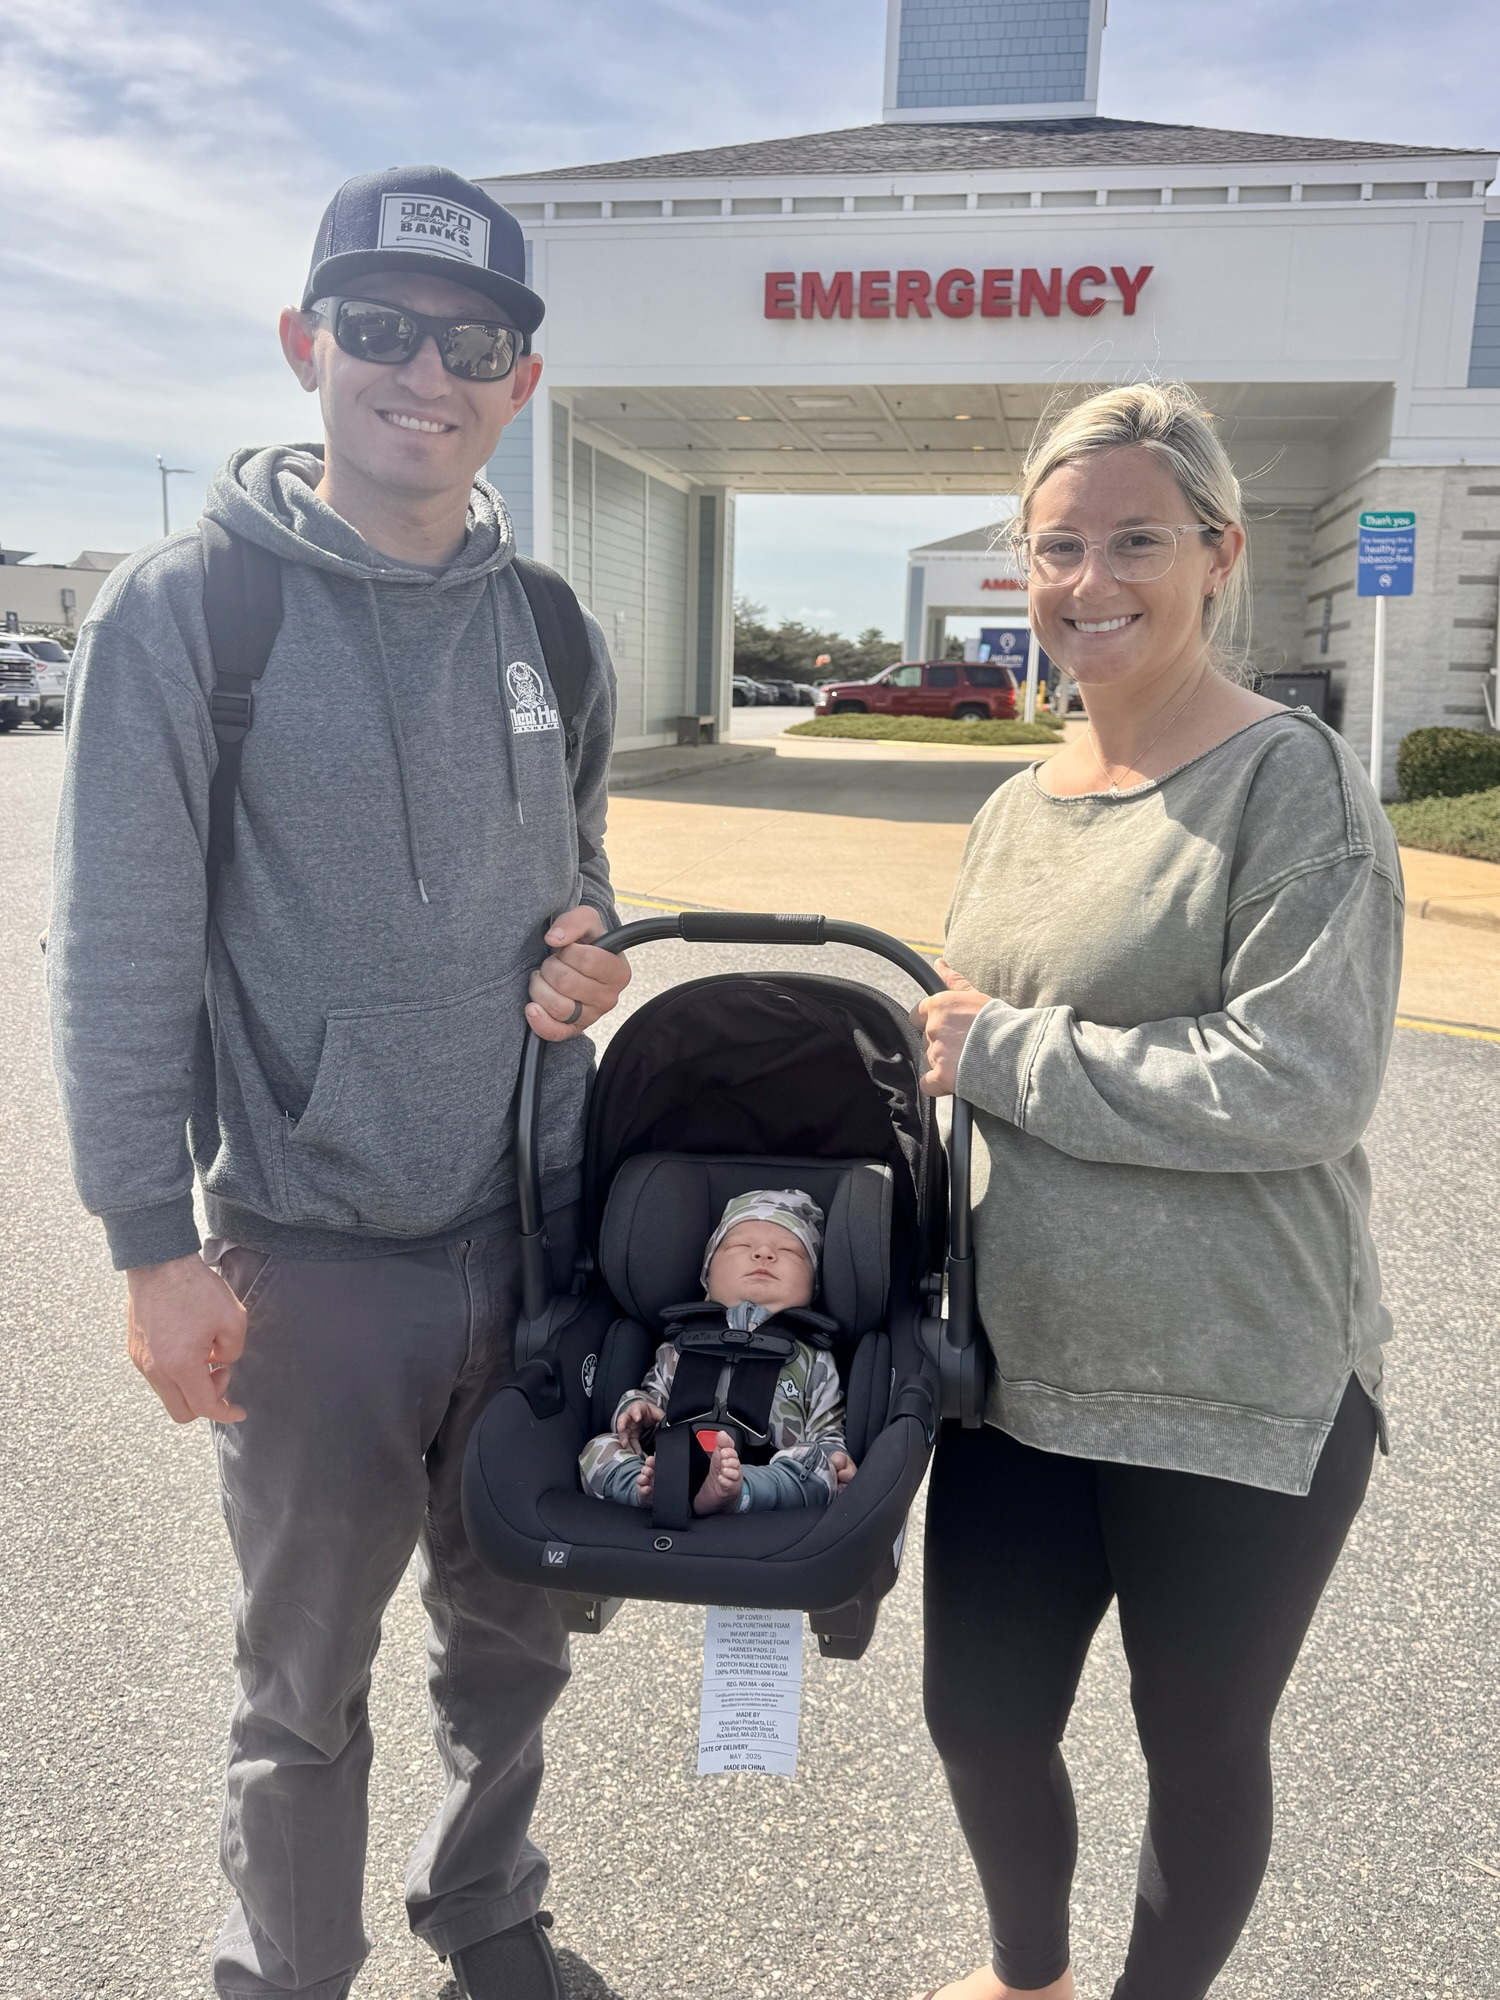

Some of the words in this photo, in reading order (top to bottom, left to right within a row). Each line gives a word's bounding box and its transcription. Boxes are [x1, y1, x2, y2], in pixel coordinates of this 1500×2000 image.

[400, 223, 470, 246] BANKS
[764, 266, 1154, 320] EMERGENCY
[1364, 515, 1392, 525] Thank
[1393, 518, 1410, 528] you
[1364, 544, 1396, 555] healthy
[1360, 553, 1413, 564] tobacco-free
[787, 1383, 793, 1392] B
[548, 1551, 565, 1564] V2
